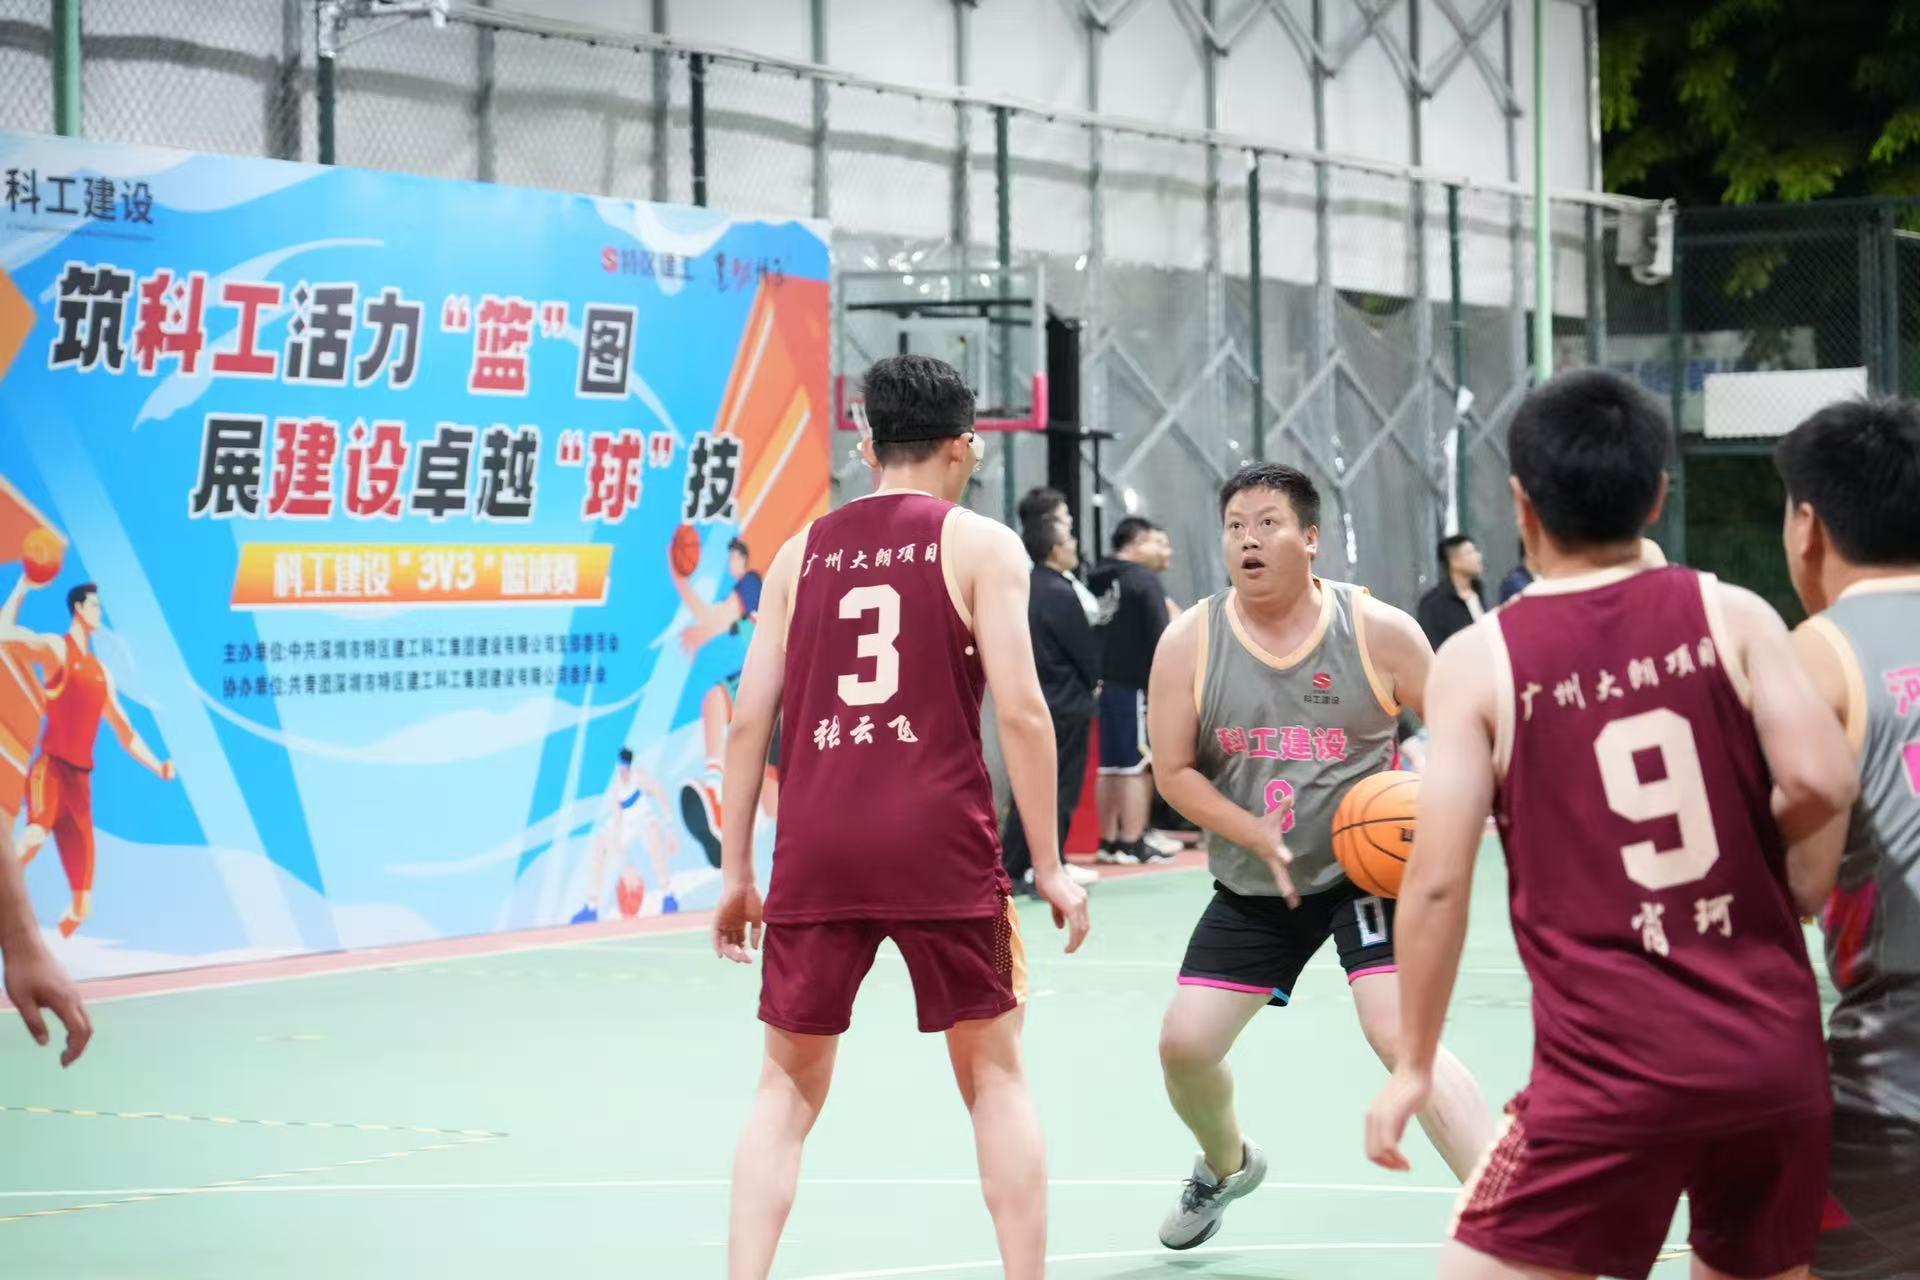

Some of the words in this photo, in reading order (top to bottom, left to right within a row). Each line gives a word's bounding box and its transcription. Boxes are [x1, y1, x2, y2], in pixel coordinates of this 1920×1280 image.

[5, 168, 154, 225] 科工建设
[803, 542, 938, 577] 广州大朗项目
[837, 584, 900, 706] 3
[1303, 694, 1341, 705] 科工建设
[1520, 636, 1717, 721] 广州大朗项目
[813, 714, 919, 751] 张云飞
[1215, 726, 1347, 761] 科工建设
[1593, 707, 1720, 890] 9
